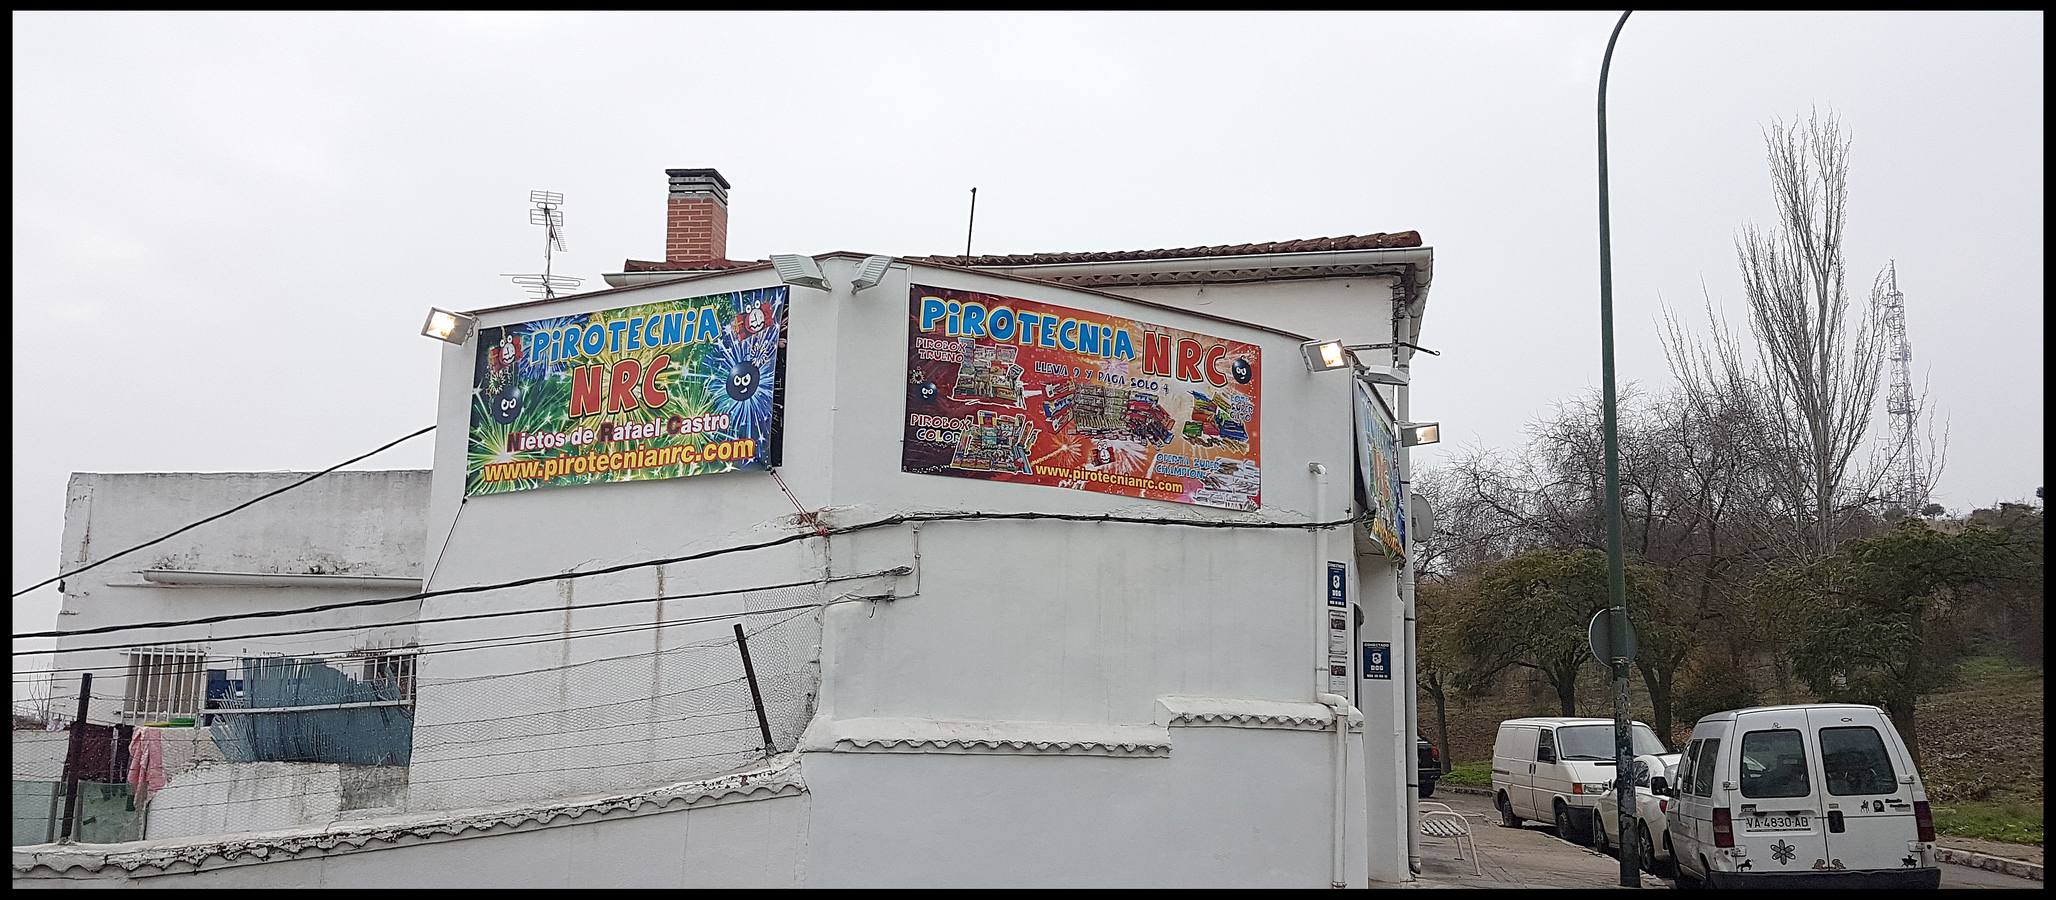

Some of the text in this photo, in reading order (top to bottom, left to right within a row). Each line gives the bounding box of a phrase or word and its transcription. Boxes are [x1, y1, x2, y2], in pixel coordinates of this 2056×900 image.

[915, 337, 968, 353] PIROBOX
[918, 349, 964, 363] TRUENO
[1141, 330, 1229, 389] NRC
[568, 354, 673, 419] NRC
[1034, 361, 1069, 377] LLEVA
[1098, 371, 1125, 385] PAGA
[1130, 377, 1159, 391] SOLO
[506, 412, 731, 453] Nietos de Rafael Castro
[910, 414, 972, 430] PIROBOX
[916, 428, 962, 444] COLOR
[484, 437, 756, 482] www.pirotecnianrc.com
[1035, 463, 1185, 493] www.pirotecnianrc.com
